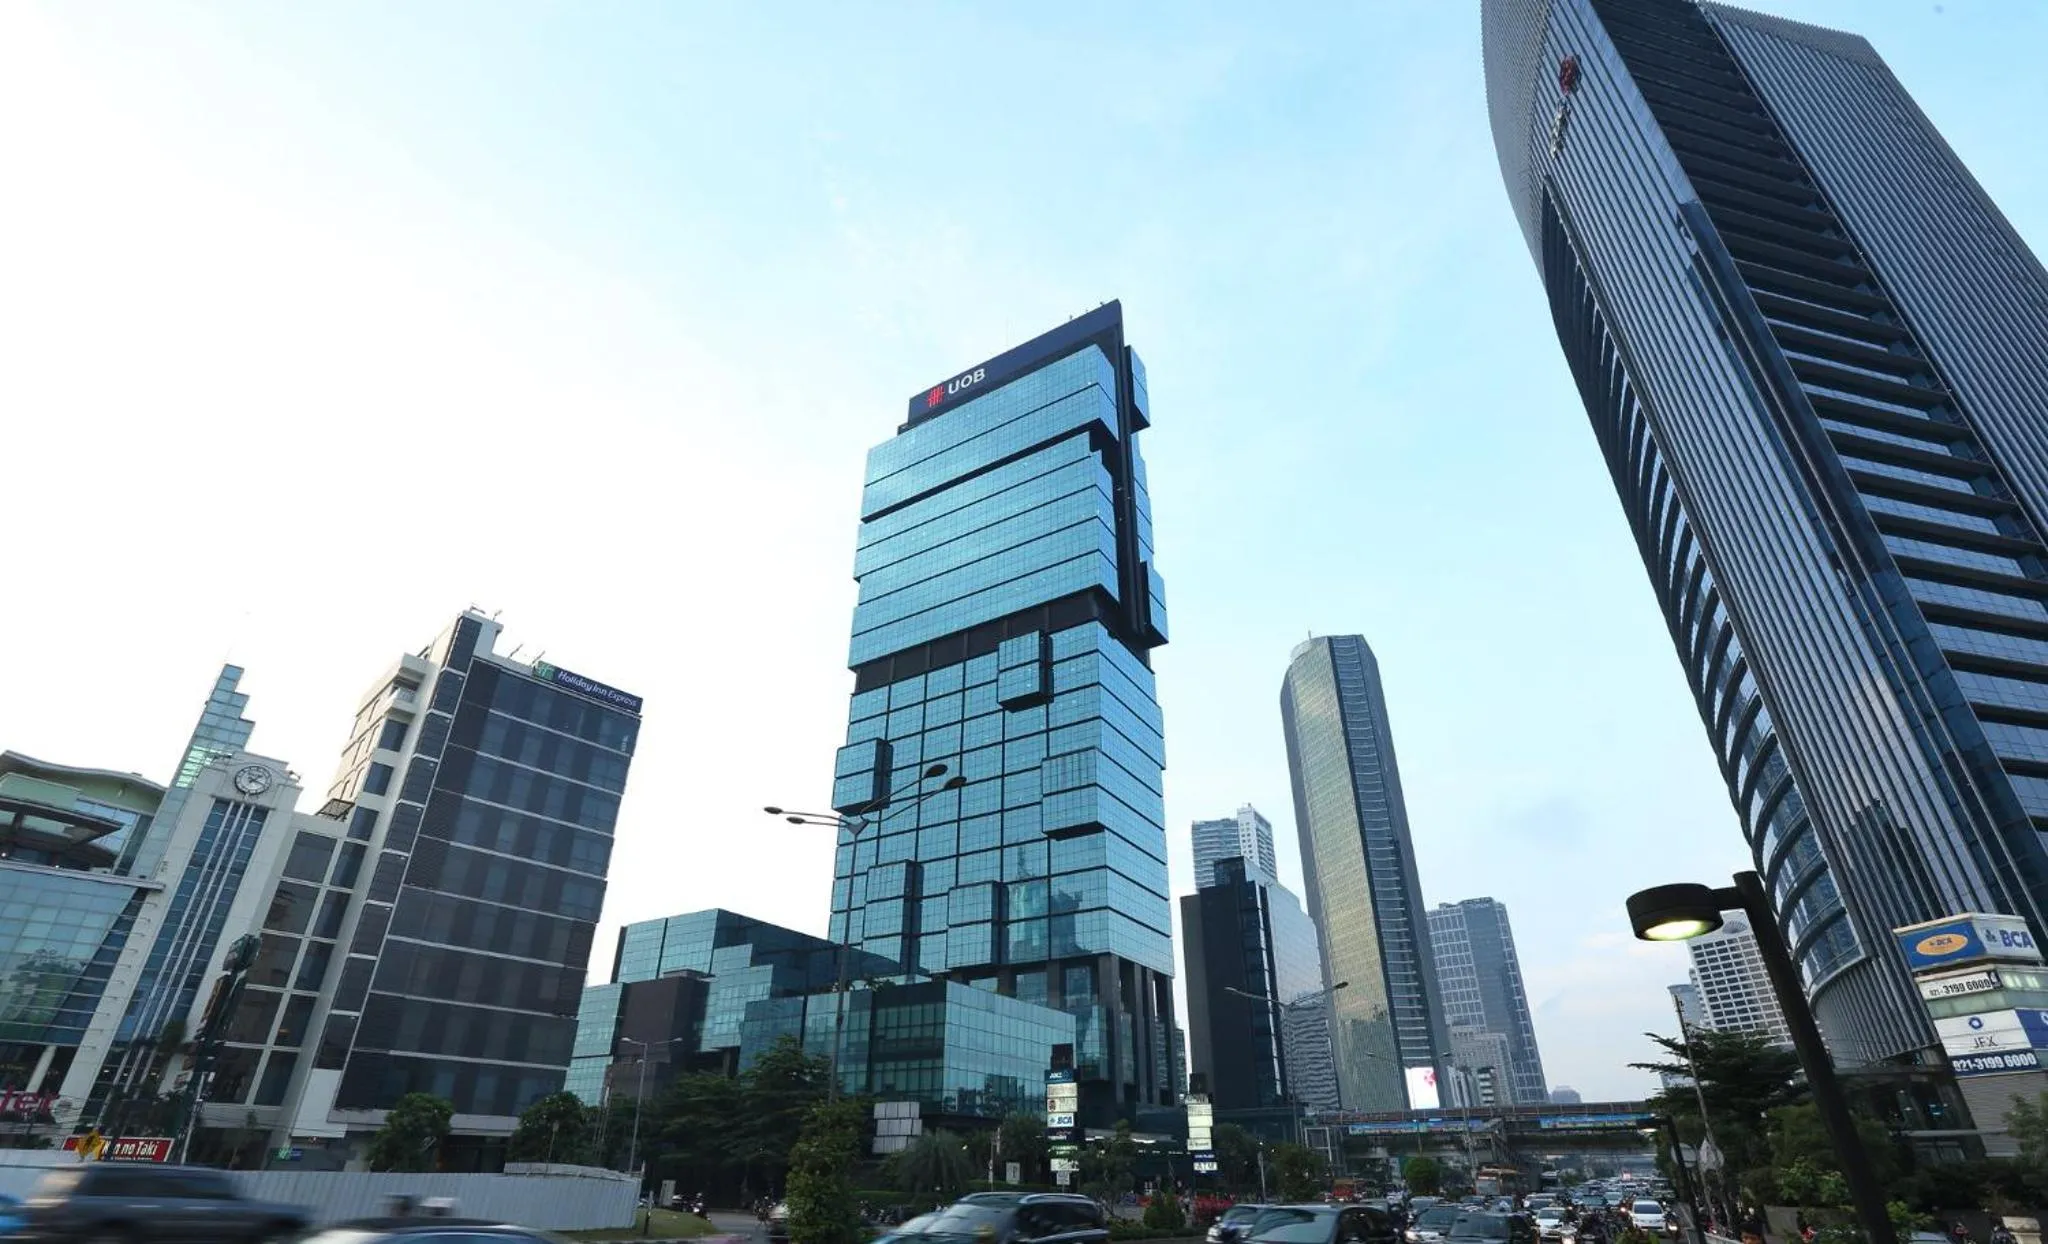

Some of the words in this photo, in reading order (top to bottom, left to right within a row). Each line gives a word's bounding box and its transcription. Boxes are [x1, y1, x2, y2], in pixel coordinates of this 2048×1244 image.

[948, 368, 985, 394] UOB
[558, 671, 592, 692] Holiday
[593, 684, 607, 697] Inn
[608, 690, 637, 707] Express
[1999, 930, 2034, 948] BCA
[1967, 979, 1992, 991] 6000
[1952, 1056, 2003, 1072] 021-3199
[2004, 1052, 2037, 1067] 6000
[136, 1141, 159, 1156] Taki
